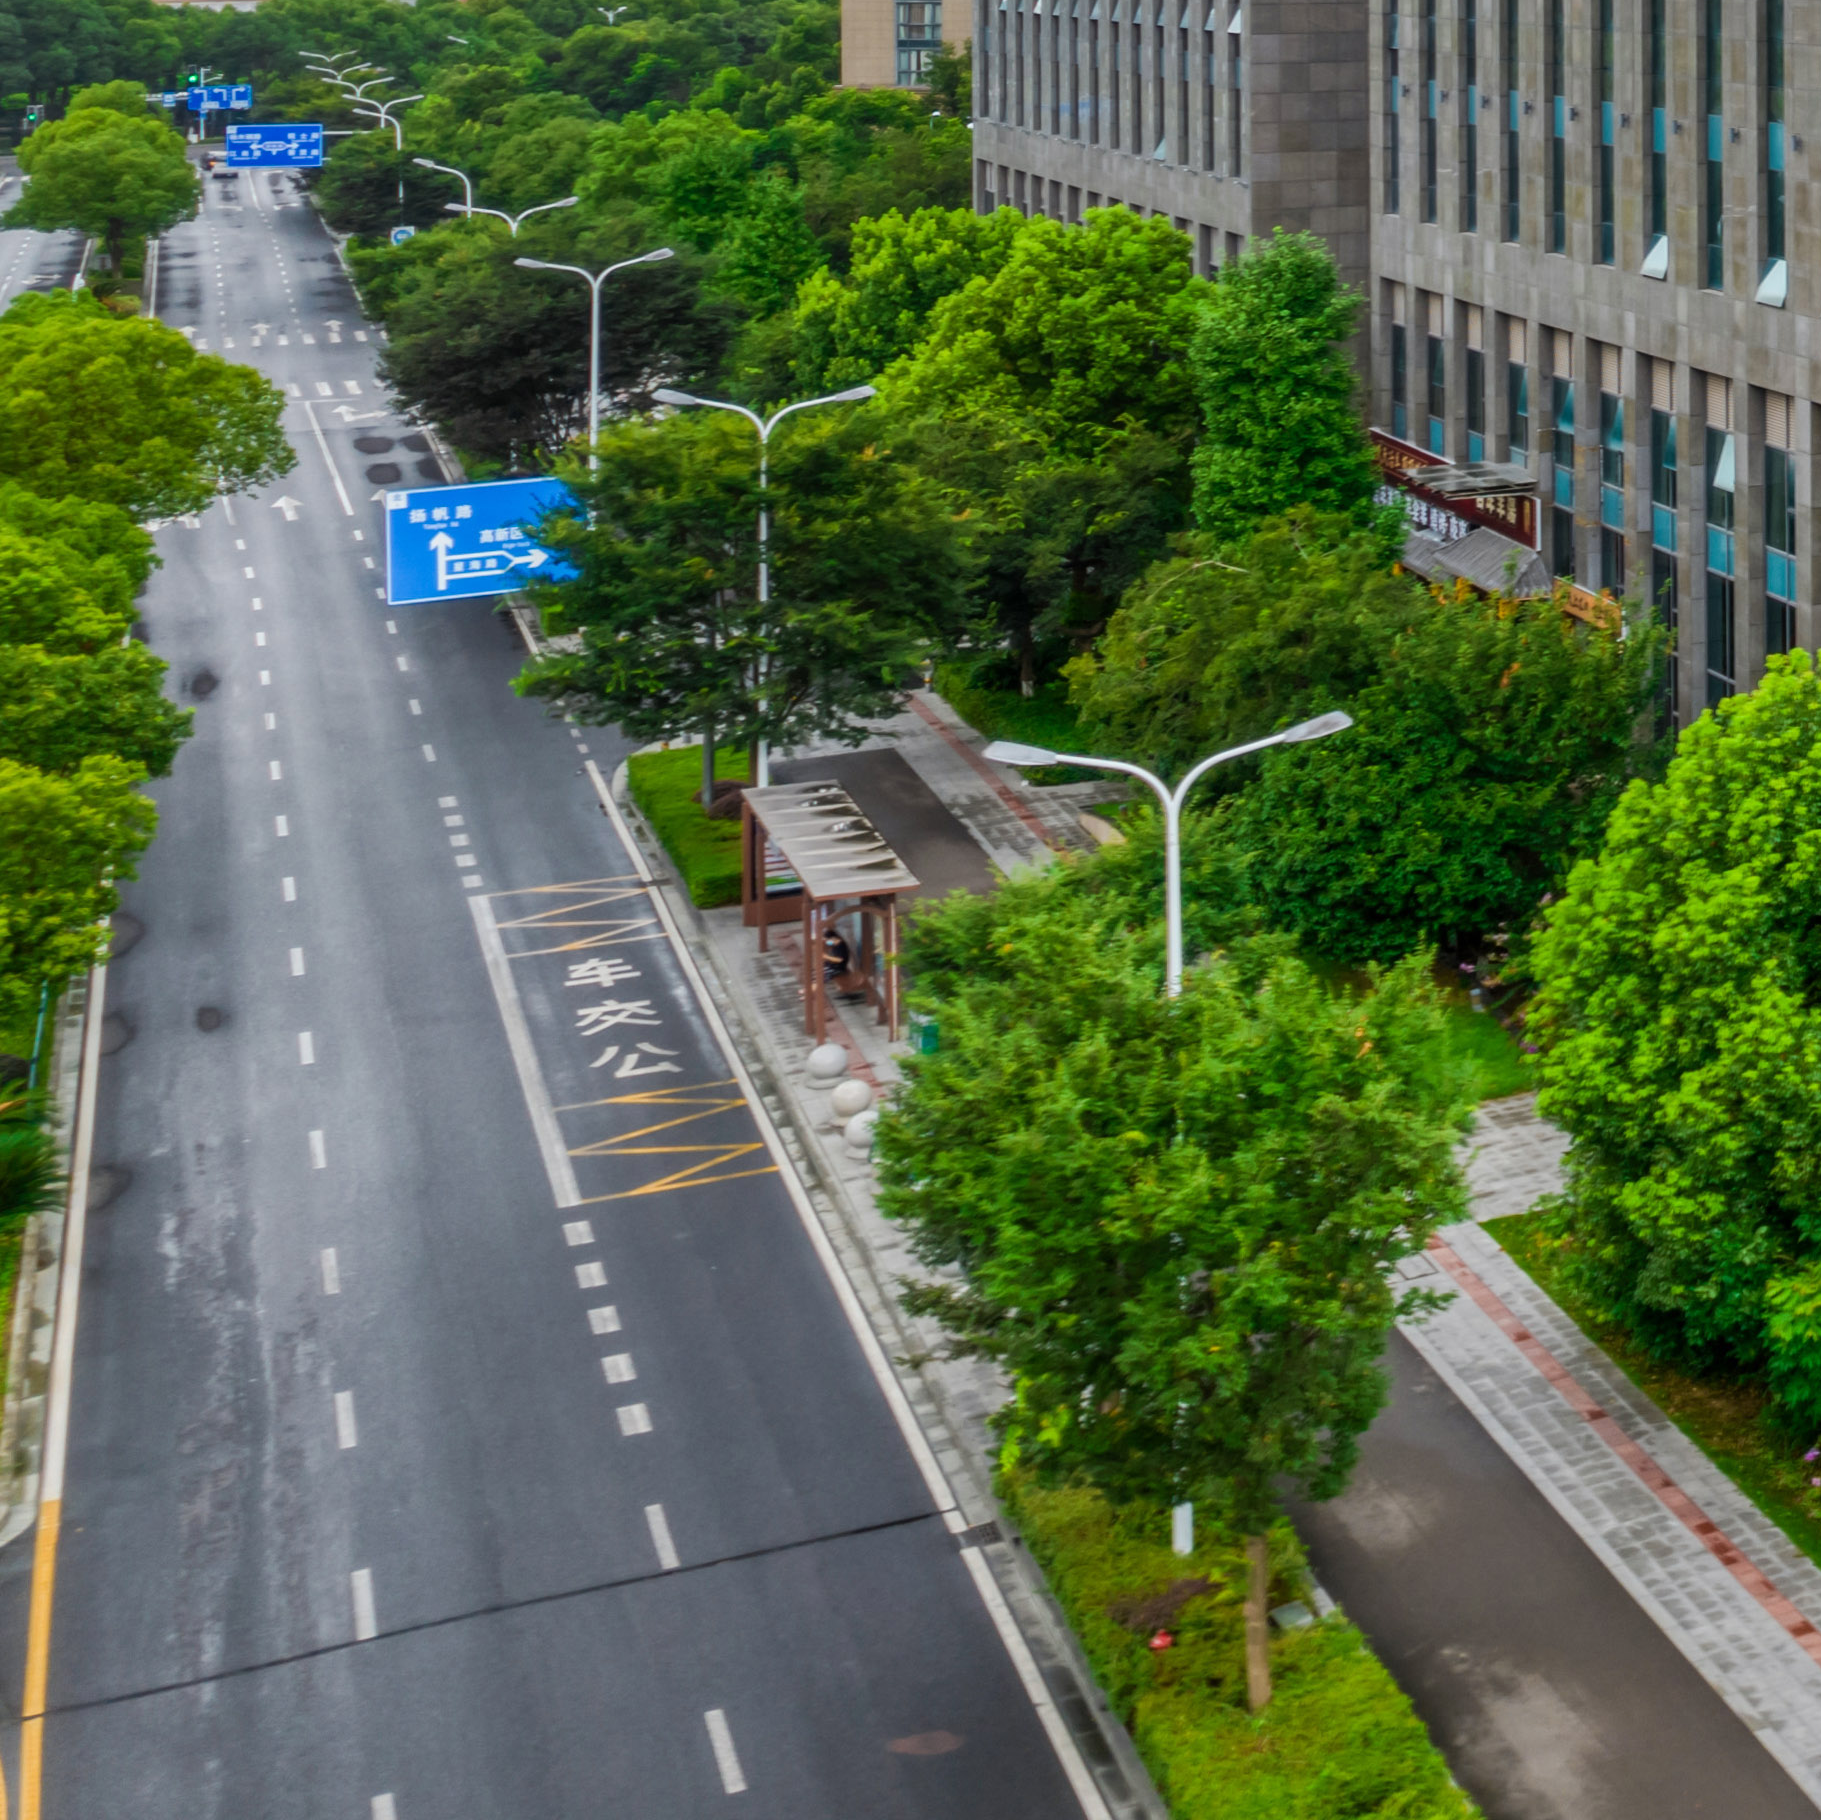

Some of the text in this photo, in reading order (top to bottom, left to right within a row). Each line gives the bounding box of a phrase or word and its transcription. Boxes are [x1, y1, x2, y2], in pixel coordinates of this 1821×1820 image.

[409, 504, 473, 524] 扬帆路
[479, 526, 525, 544] 高新区
